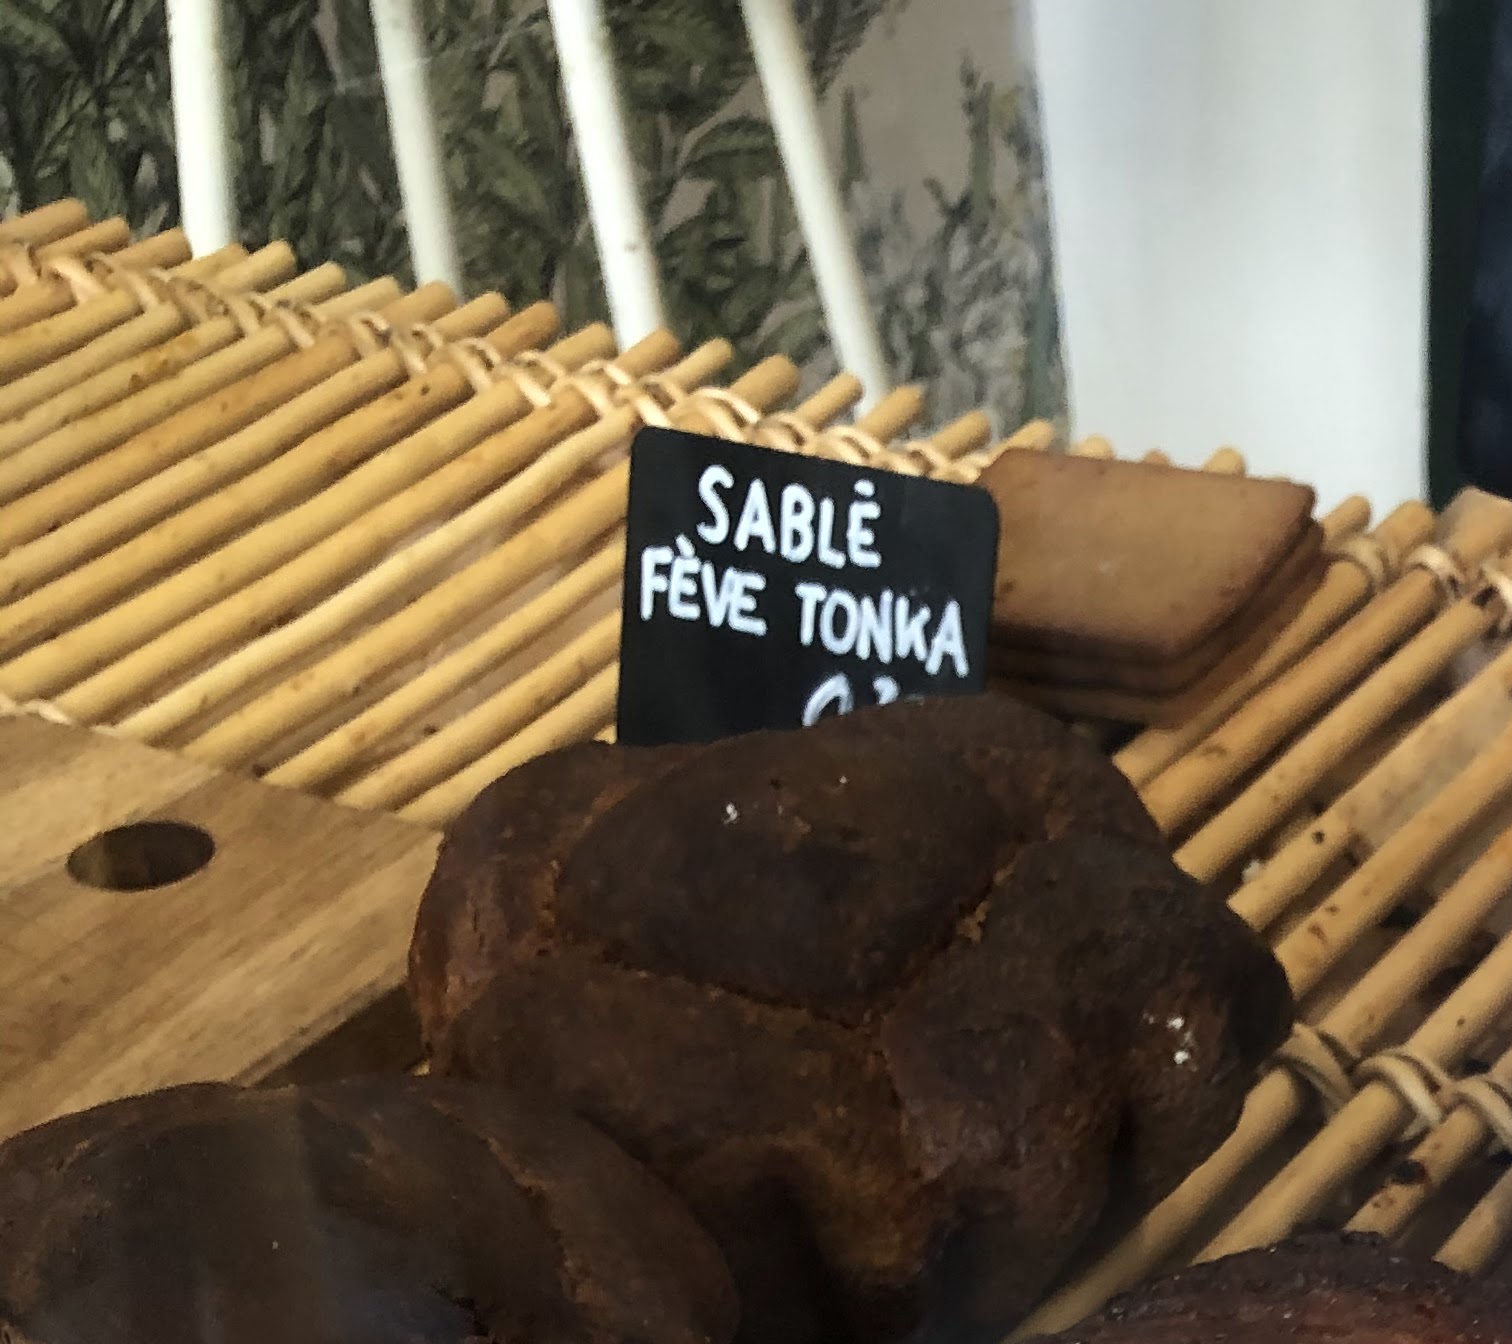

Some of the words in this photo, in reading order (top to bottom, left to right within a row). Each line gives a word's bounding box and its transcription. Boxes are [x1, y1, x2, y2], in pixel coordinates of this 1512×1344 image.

[696, 464, 883, 569] SABLÉ
[640, 534, 768, 637] FÈVE
[794, 580, 970, 679] TONKA
